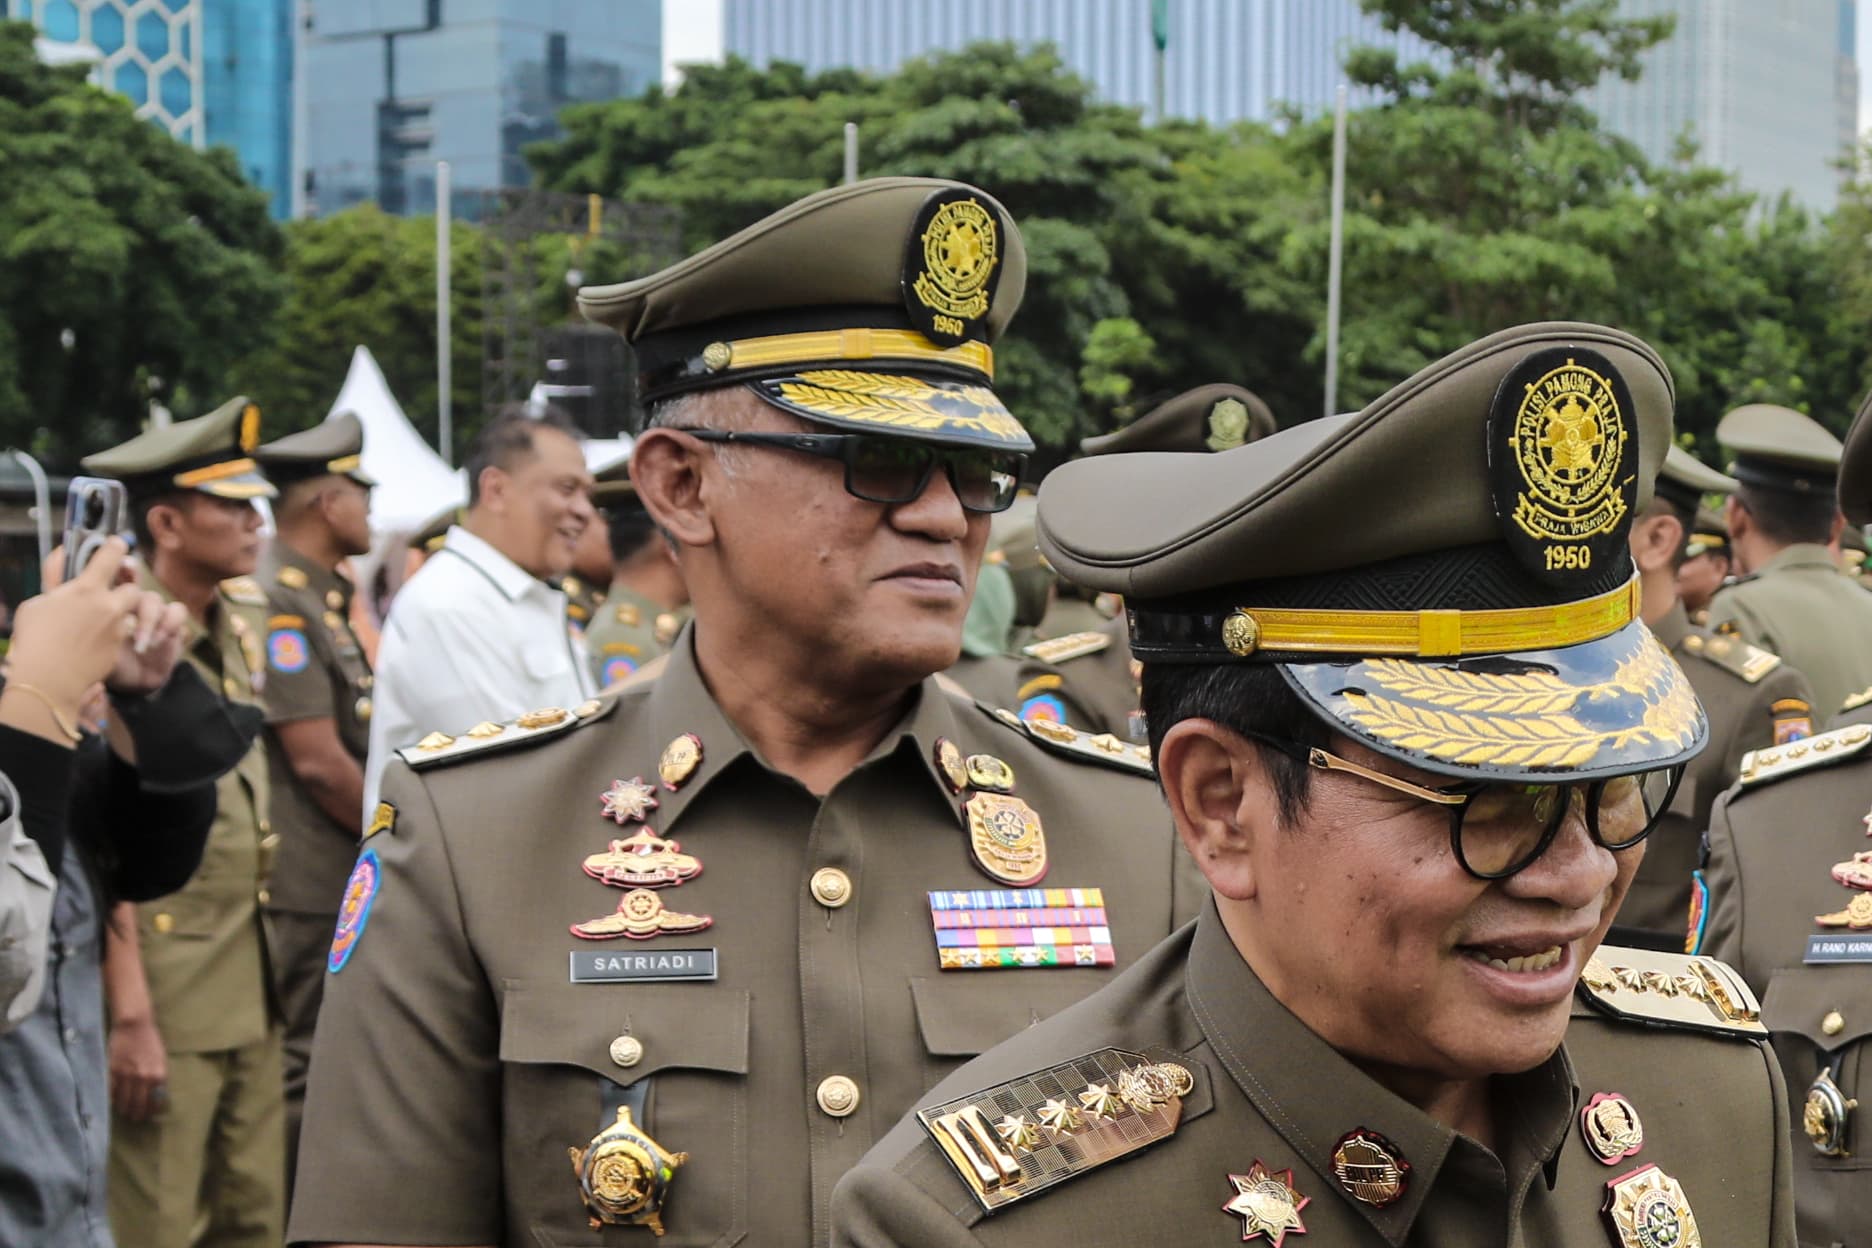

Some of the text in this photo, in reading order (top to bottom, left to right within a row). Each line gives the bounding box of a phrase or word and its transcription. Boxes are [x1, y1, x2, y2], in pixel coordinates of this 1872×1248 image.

[1520, 373, 1617, 436] POLISI PAMONG PRAJA
[1544, 546, 1591, 570] 1950
[594, 955, 694, 971] SATRIADI
